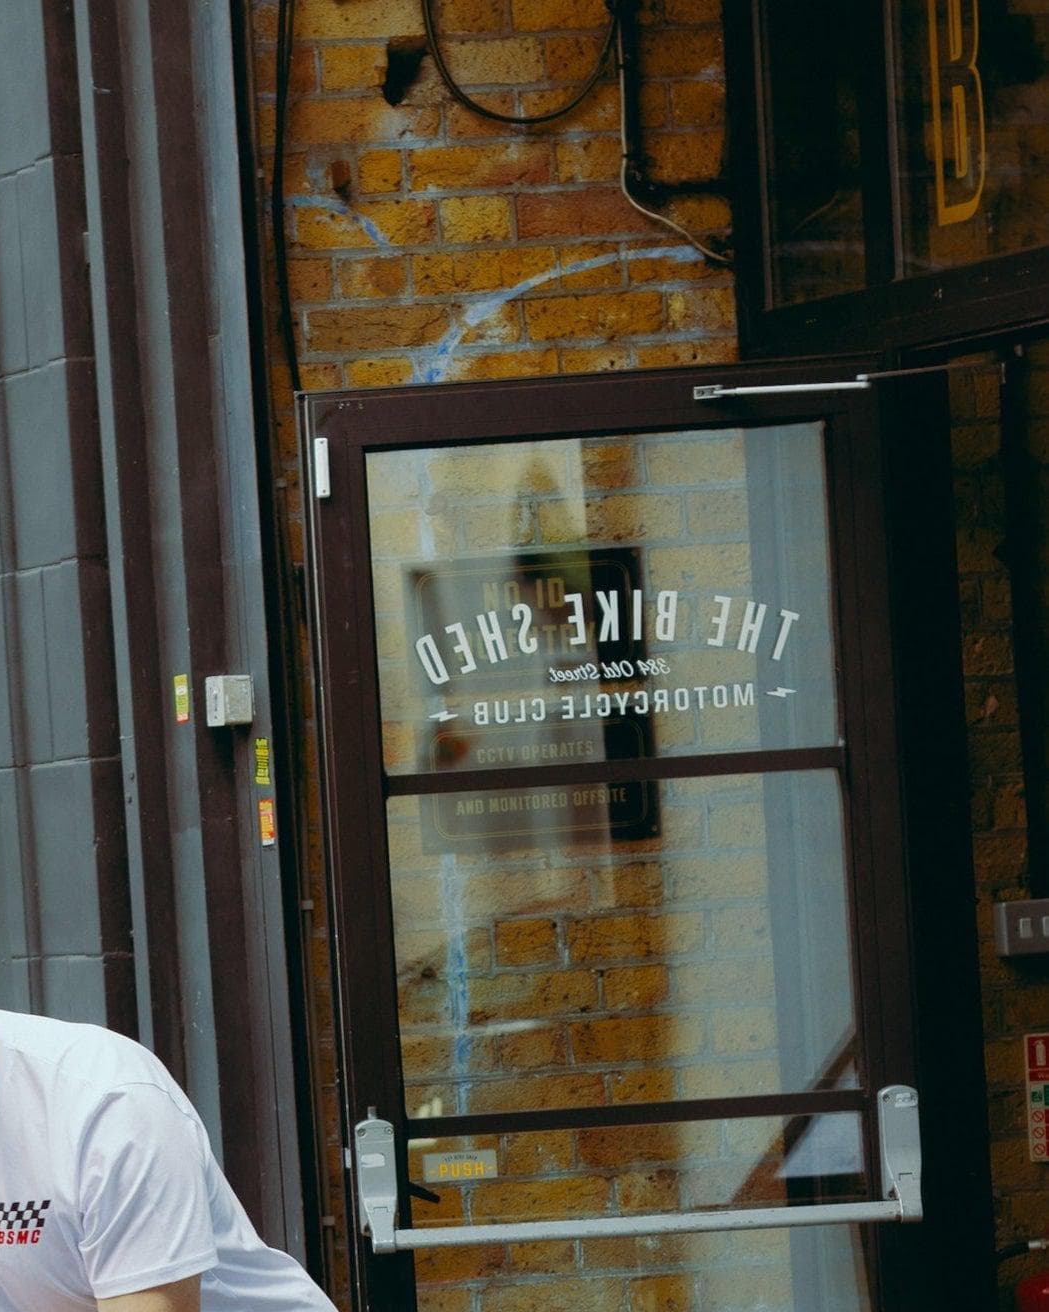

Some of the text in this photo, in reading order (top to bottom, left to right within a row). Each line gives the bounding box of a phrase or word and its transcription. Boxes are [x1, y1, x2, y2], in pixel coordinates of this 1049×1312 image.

[476, 741, 594, 764] CCTV OPERATES
[456, 800, 484, 816] AND
[489, 793, 568, 813] MONITORED
[438, 1161, 484, 1178] PUSH
